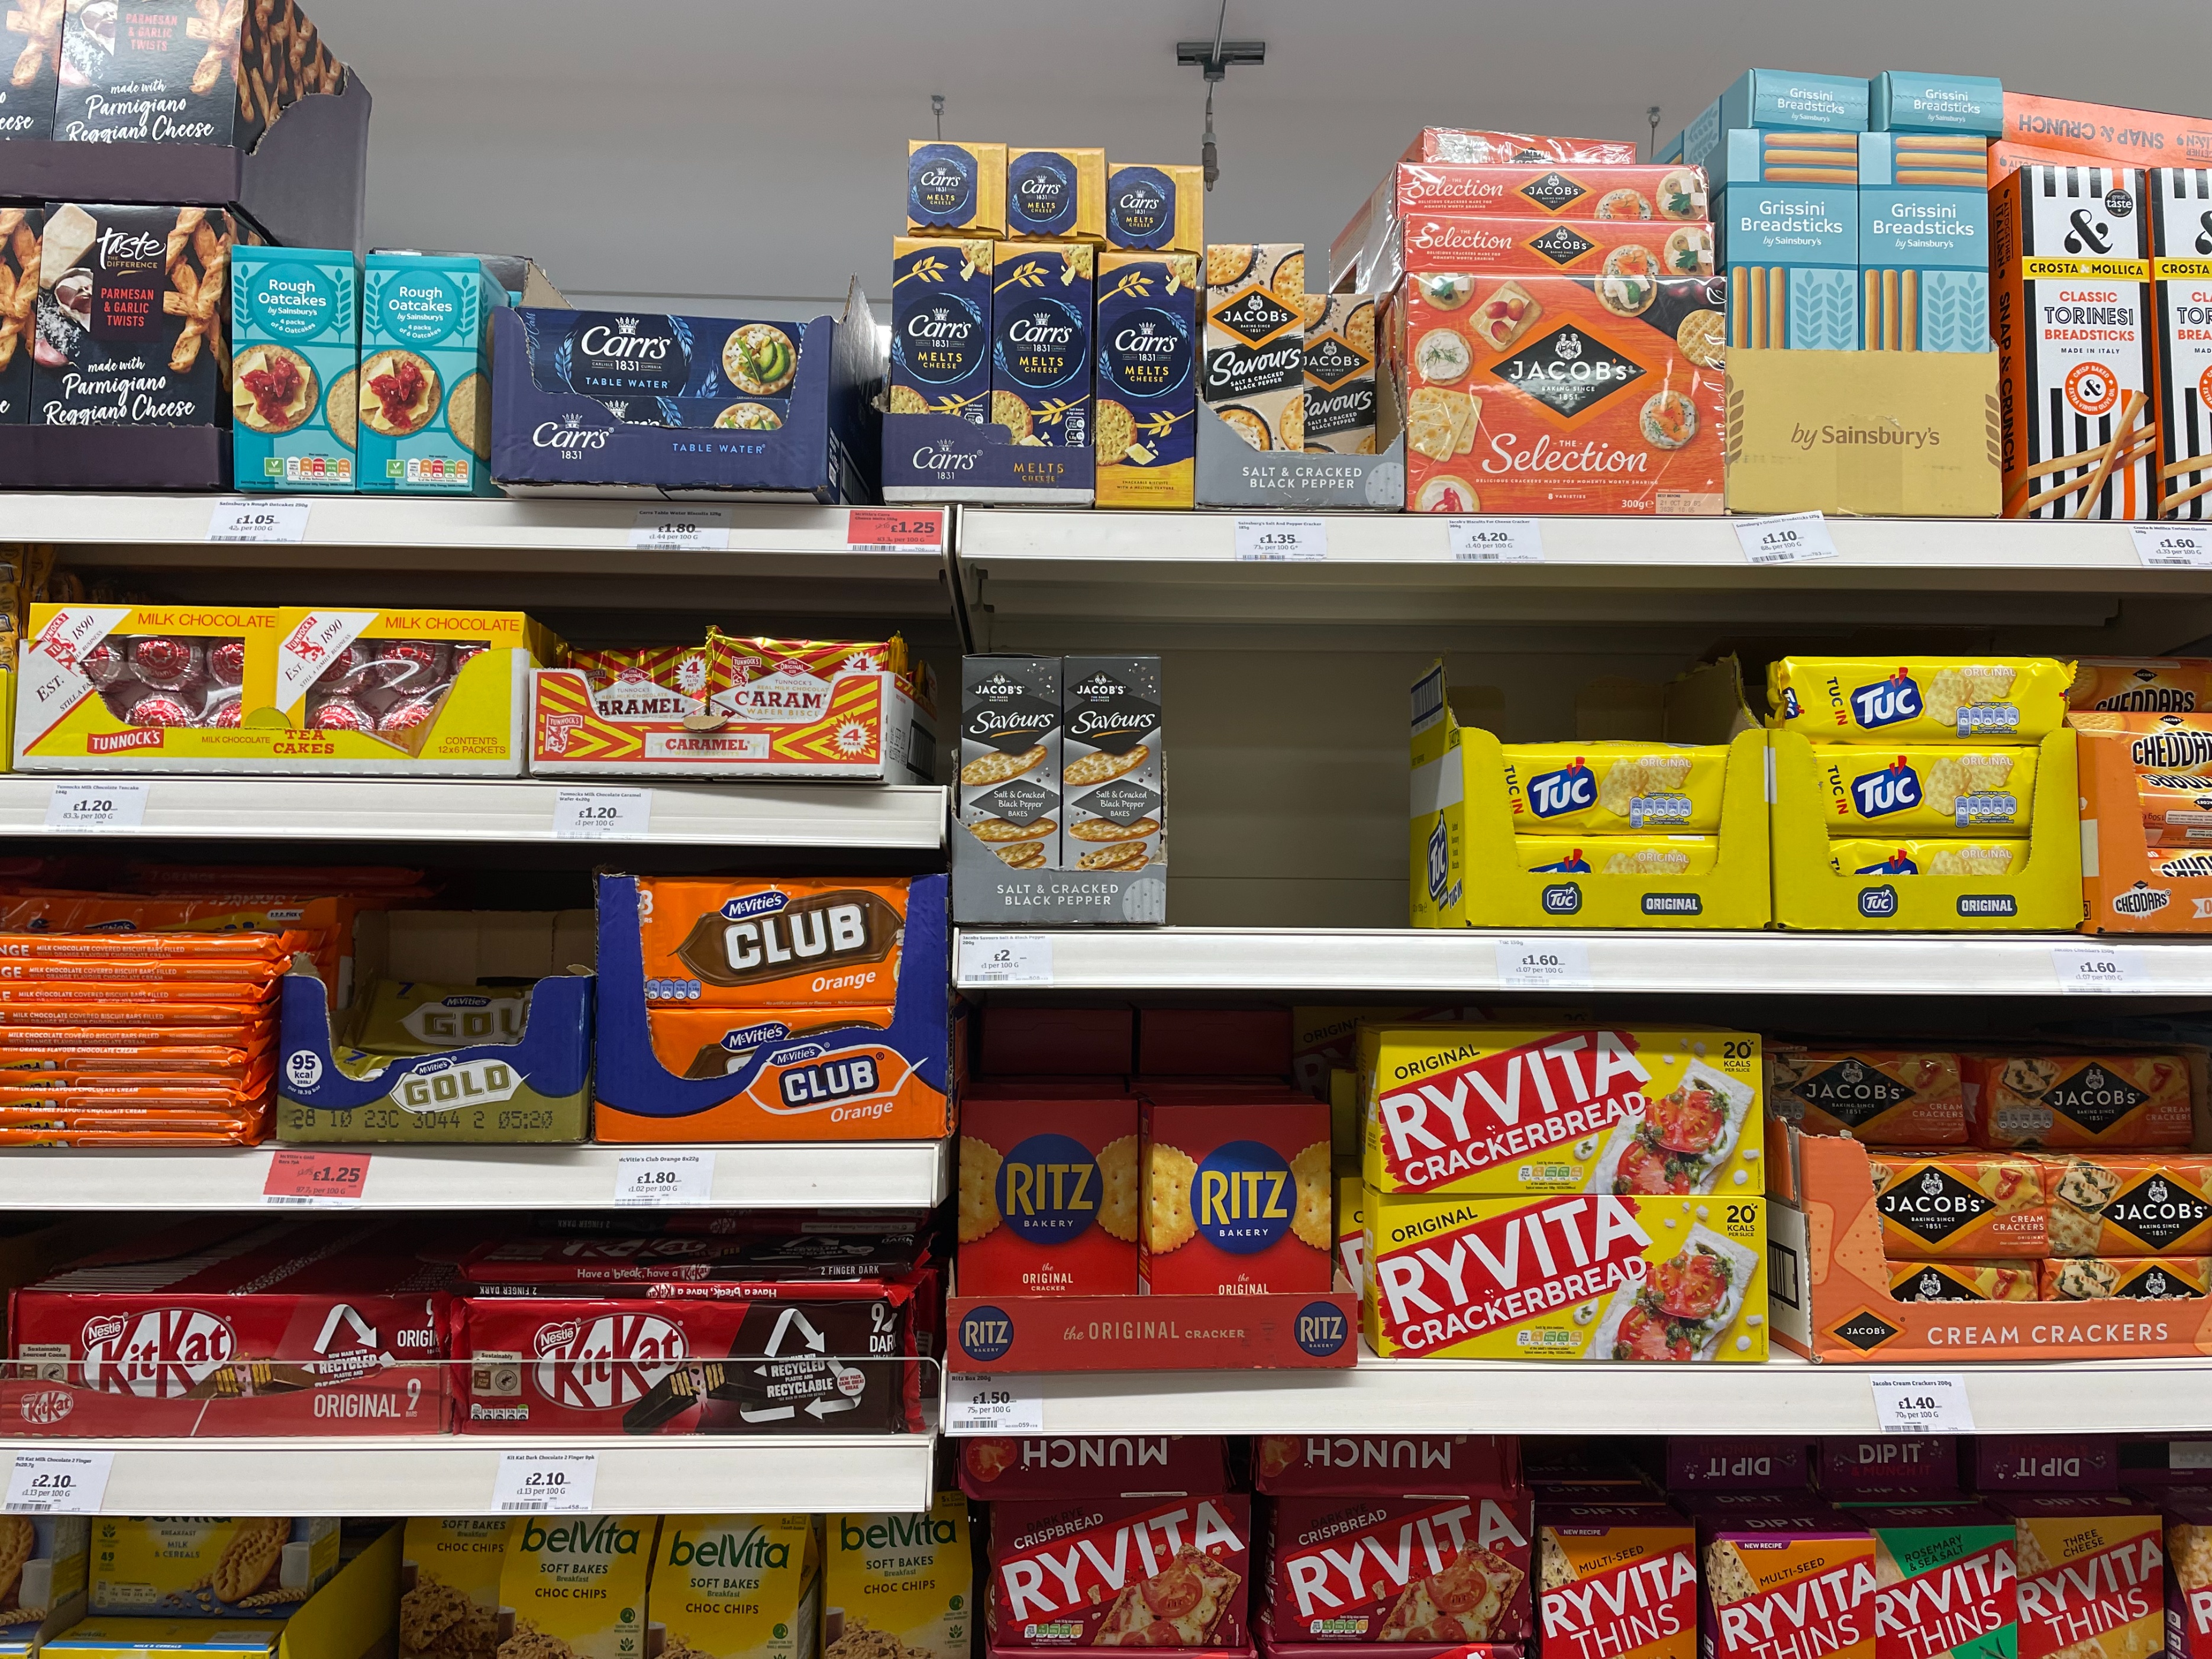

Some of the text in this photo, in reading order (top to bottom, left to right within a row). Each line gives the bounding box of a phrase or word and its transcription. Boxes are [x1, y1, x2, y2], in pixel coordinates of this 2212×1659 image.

[111, 80, 167, 94] made with
[2019, 114, 2165, 149] SNAP & CRUNCH
[921, 172, 961, 187] Carr's
[1759, 200, 1825, 216] Grissini
[2106, 199, 2132, 208] taste
[1741, 217, 1843, 233] Breadsticks
[96, 227, 166, 270] taste
[106, 260, 158, 270] DIFFERENCE
[2029, 263, 2143, 275] CROSTA MOLLICA
[269, 279, 315, 294] Rough
[101, 288, 154, 302] PARMESAN
[258, 293, 327, 306] Oatcakes
[2059, 291, 2117, 302] CLASSIC
[104, 302, 149, 315] & GARLIC
[268, 306, 317, 316] by Sainsbury's
[2045, 306, 2134, 325] TORINESI
[106, 314, 144, 327] TWISTS
[908, 315, 972, 340] Carr's
[581, 324, 671, 359] Carr's
[1115, 329, 1178, 353] Carr's
[2045, 330, 2135, 341] BREADSTICKS
[918, 352, 963, 363] MELTS
[1139, 353, 1156, 362] 1831
[1125, 366, 1169, 376] MELTS
[1209, 347, 1301, 386] Savours
[585, 377, 669, 389] TABLE WATER
[1254, 371, 1284, 383] CRACKED
[63, 373, 166, 406] Parmigiano
[1235, 377, 1282, 392] BLACK PEPPER
[132, 393, 195, 421] Cheese
[532, 421, 610, 449] Carr's
[1791, 422, 1940, 450] by Sainsbury's
[672, 443, 762, 454] TABLE WATER
[1481, 433, 1648, 474] Selection
[237, 515, 275, 524] £1.05
[658, 524, 696, 532] £1.80
[891, 522, 935, 532] £1.25
[1260, 534, 1296, 544] £1.35
[1472, 532, 1507, 541] £4.20
[1762, 531, 1797, 544] £1.10
[2161, 539, 2194, 548] £1.60
[138, 614, 275, 628] MILK CHOCOLATE
[976, 686, 1022, 694] JACOB'S
[970, 711, 1054, 734] Savours
[92, 731, 160, 750] TUNNOCK'S
[285, 730, 325, 740] TEA
[273, 743, 334, 754] CAKES
[665, 738, 750, 751] CARAMEL
[1640, 758, 1691, 768] ORIGINAL
[1018, 790, 1045, 799] Cracked
[73, 801, 112, 811] £1.20
[998, 800, 1042, 809] Black Pepper
[579, 807, 616, 818] £1.20
[729, 893, 782, 916] McVitie's
[1646, 898, 1697, 911] ORIGINAL
[2116, 890, 2169, 913] CHEDDARS
[725, 904, 866, 970] CLUB
[994, 950, 1010, 961] £2
[1522, 955, 1558, 966] £1.60
[2081, 962, 2116, 973] £1.60
[812, 971, 876, 993] Orange
[292, 1055, 316, 1070] 95
[1394, 1043, 1480, 1080] ORIGINAL
[295, 1071, 313, 1079] kcal
[403, 1064, 511, 1105] GOLD
[1380, 1031, 1652, 1162] RYVITA
[1404, 1091, 1646, 1186] CRACKERBREAD
[313, 1167, 360, 1182] £1.25
[637, 1172, 676, 1184] £1.80
[1202, 1171, 1288, 1225] RITZ
[821, 1266, 879, 1276] 2 FINGER DARK
[1064, 1321, 1245, 1341] the ORIGINAL CRACKER
[1927, 1323, 2168, 1345] CREAM CRACKERS
[551, 1316, 681, 1406] KitKat
[767, 1378, 833, 1398] RECYCLABLE
[973, 1392, 1010, 1404] £1.50
[1898, 1397, 1935, 1409] £1.40
[314, 1394, 401, 1418] ORIGINAL
[1023, 1438, 1167, 1468] MUNCH
[1859, 1444, 1922, 1463] DIP IT
[32, 1474, 71, 1487] £2.10
[526, 1473, 564, 1485] £2.10
[520, 1517, 641, 1555] belVita
[1014, 1513, 1103, 1550] CRISPBREAD
[2063, 1529, 2098, 1547] THREE
[1904, 1535, 1962, 1563] ROSEMARY
[2063, 1537, 2105, 1558] CHEESE
[1579, 1545, 1645, 1573] MULTI-SEED
[540, 1563, 608, 1575] SOFT BAKES
[2017, 1537, 2163, 1625] RYVITA
[535, 1588, 607, 1599] CHOC CHIPS
[1542, 1551, 1696, 1639] RYVITA
[2044, 1589, 2149, 1647] THINS
